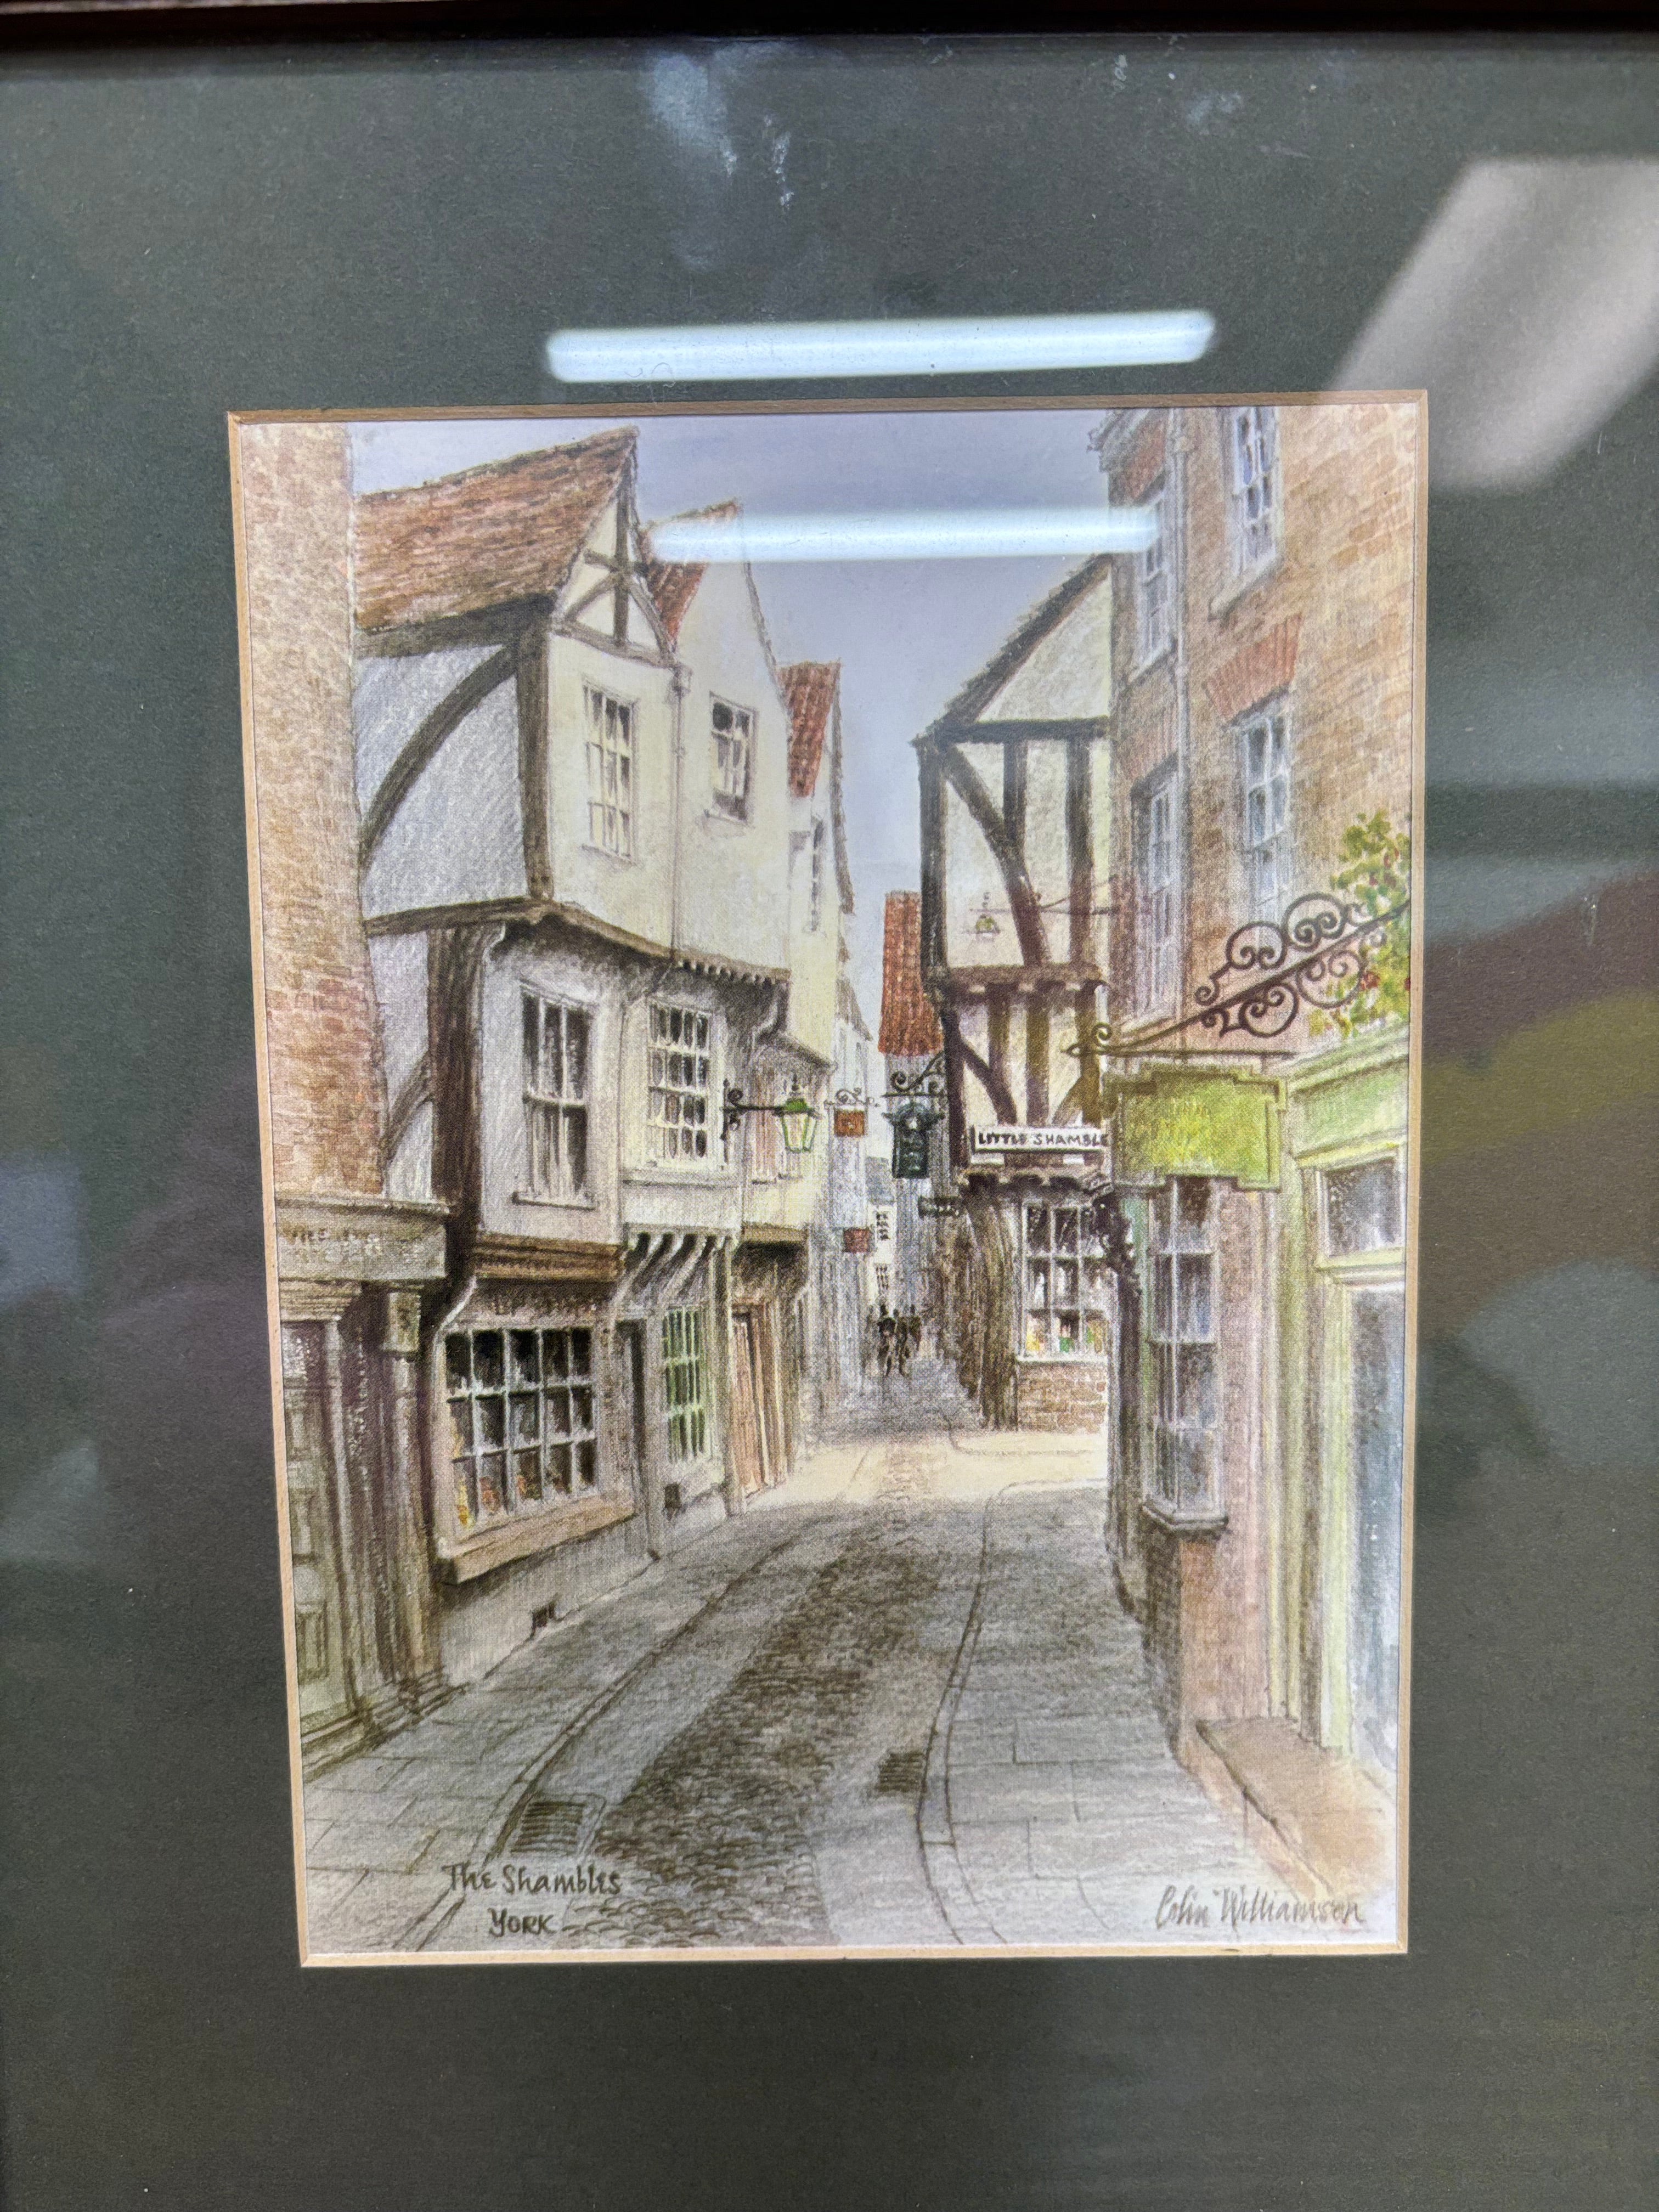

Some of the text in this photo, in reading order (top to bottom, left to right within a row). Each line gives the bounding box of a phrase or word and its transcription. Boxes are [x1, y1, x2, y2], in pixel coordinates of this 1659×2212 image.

[978, 1132, 1027, 1145] LITTLE
[442, 1860, 622, 1894] The Shambles
[1155, 1884, 1367, 1936] Colin Williamson
